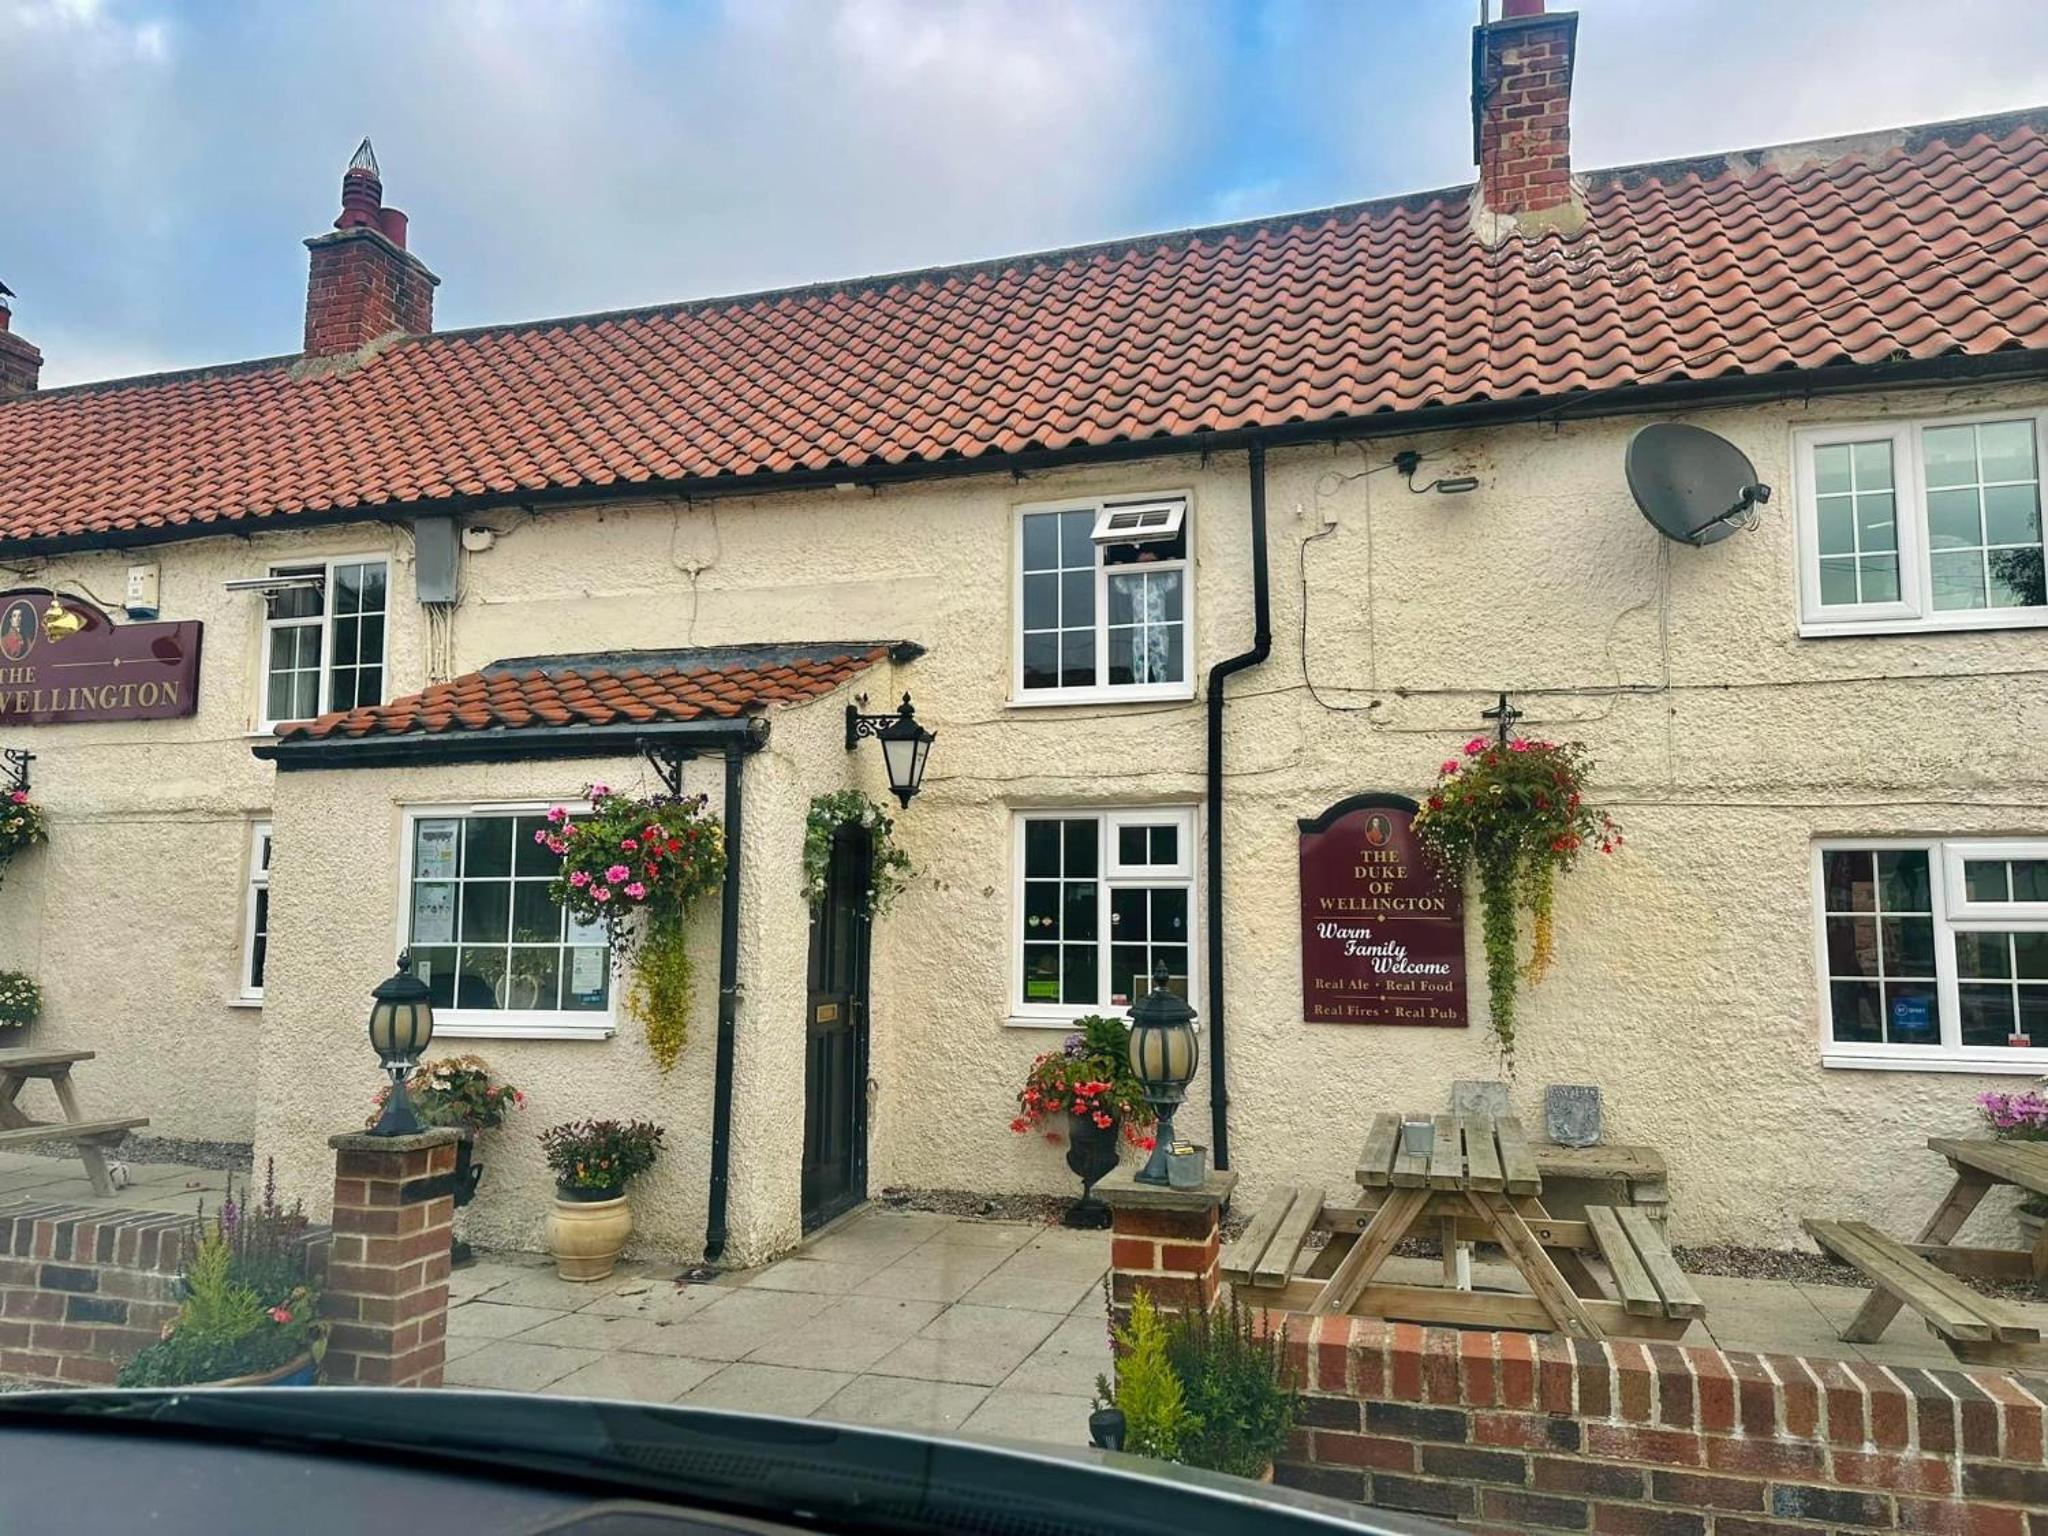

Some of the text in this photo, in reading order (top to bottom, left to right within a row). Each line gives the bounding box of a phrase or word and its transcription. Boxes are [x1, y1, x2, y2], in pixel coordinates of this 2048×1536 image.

[1360, 850, 1399, 862] THE
[1354, 866, 1408, 879] DUKE
[1369, 881, 1394, 894] OF
[1320, 897, 1445, 910] WELLINGTON
[1316, 922, 1372, 939] Warm
[1344, 940, 1408, 961] Family
[1371, 957, 1451, 975] Welcome
[1315, 978, 1453, 993] Real Ale Real Food
[1314, 1004, 1458, 1019] Real Fires Real Pub
